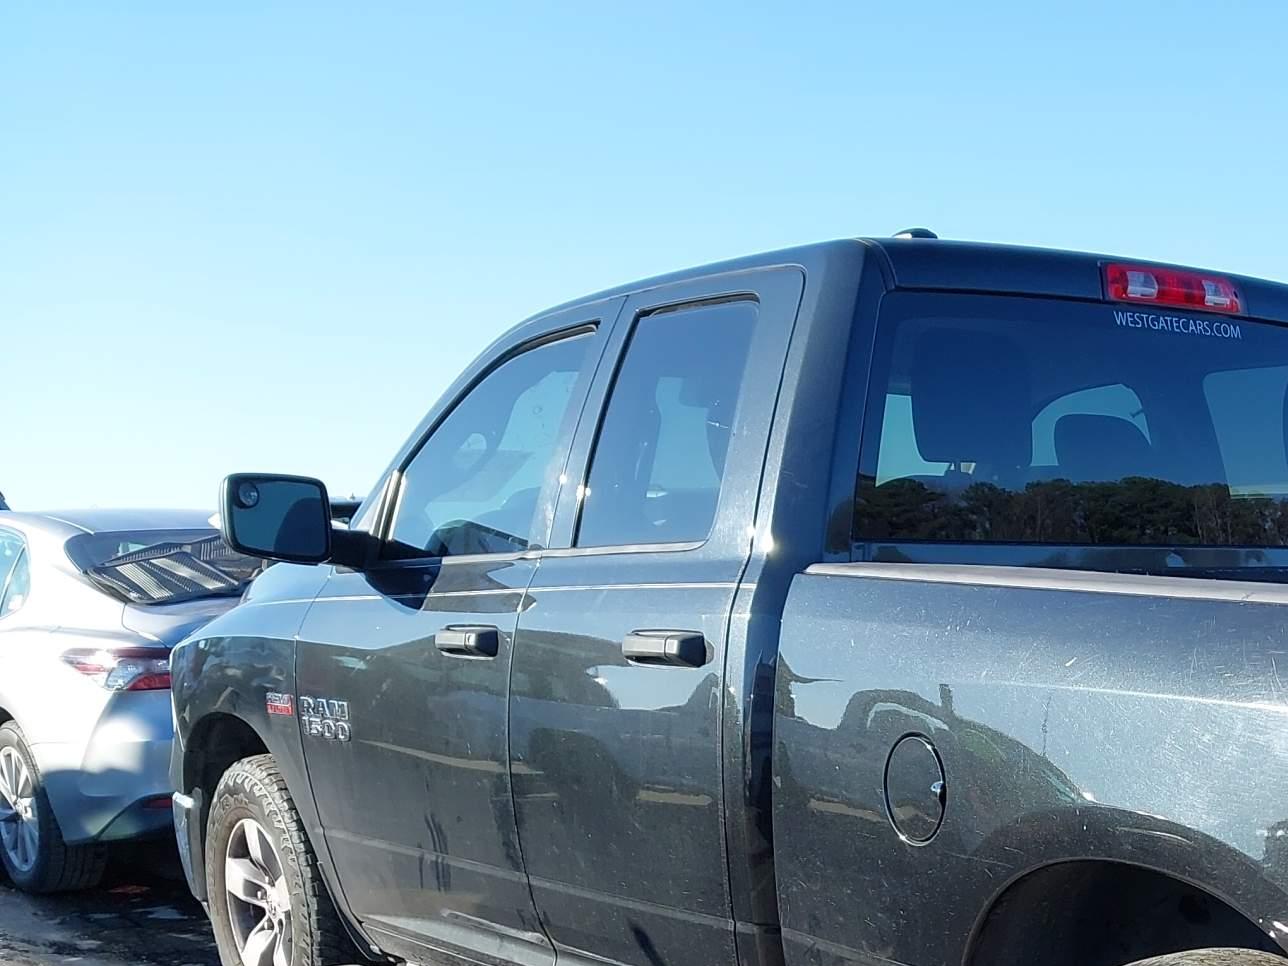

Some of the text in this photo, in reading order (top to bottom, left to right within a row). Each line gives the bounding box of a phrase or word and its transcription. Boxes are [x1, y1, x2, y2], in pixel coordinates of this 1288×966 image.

[1113, 310, 1242, 339] WESTGATECARS.COM
[299, 696, 350, 721] RAM
[301, 715, 352, 742] 1500
